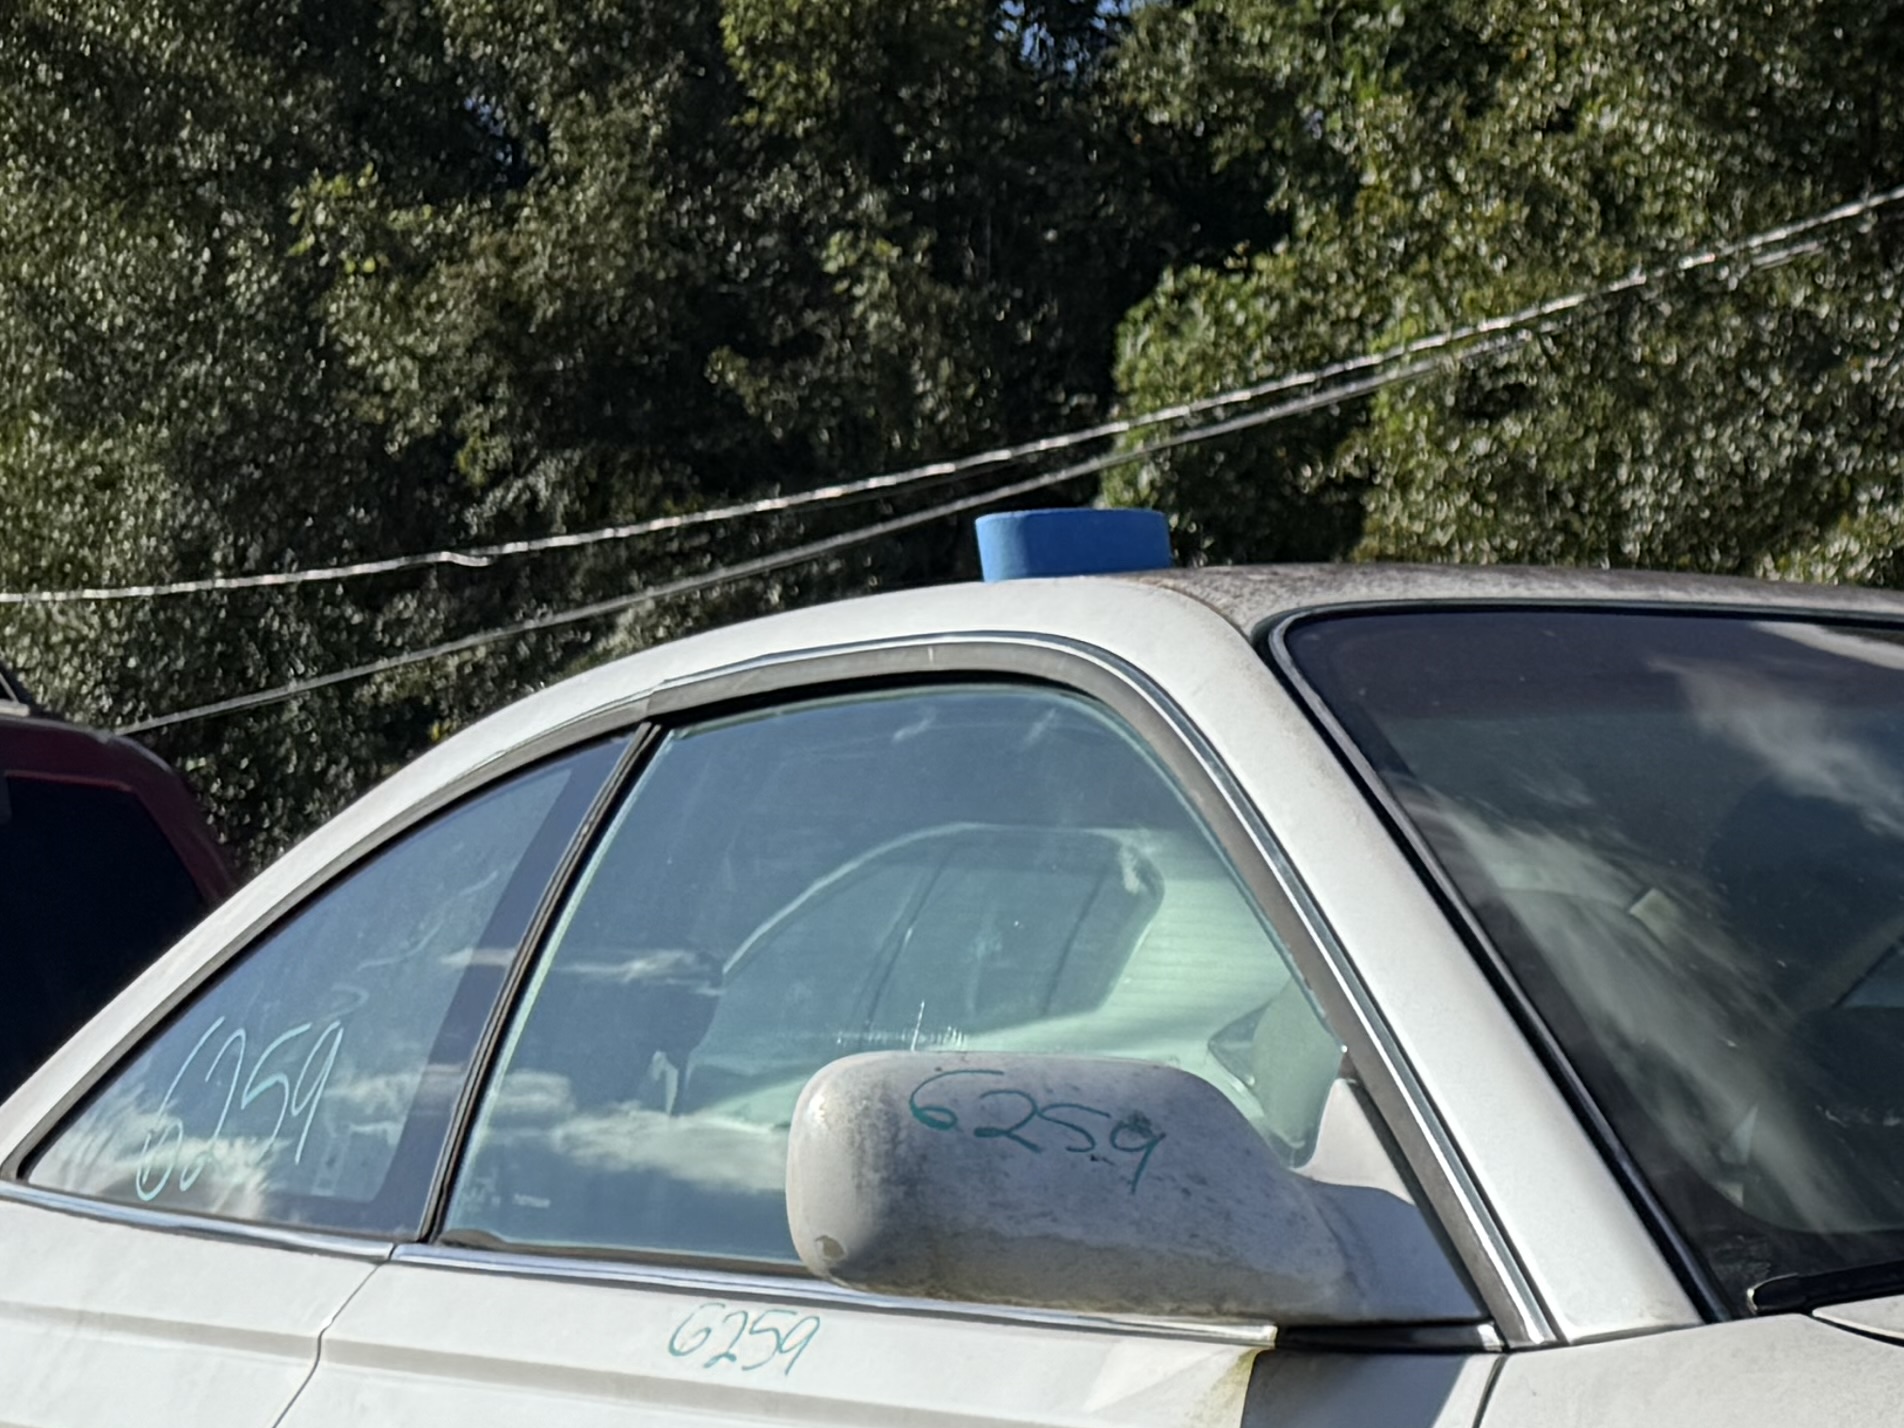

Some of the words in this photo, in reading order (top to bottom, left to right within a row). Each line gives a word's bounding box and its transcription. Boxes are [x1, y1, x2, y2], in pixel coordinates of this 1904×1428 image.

[135, 1015, 344, 1201] 6259
[908, 1068, 1167, 1195] 6259
[667, 1302, 821, 1376] 6259
